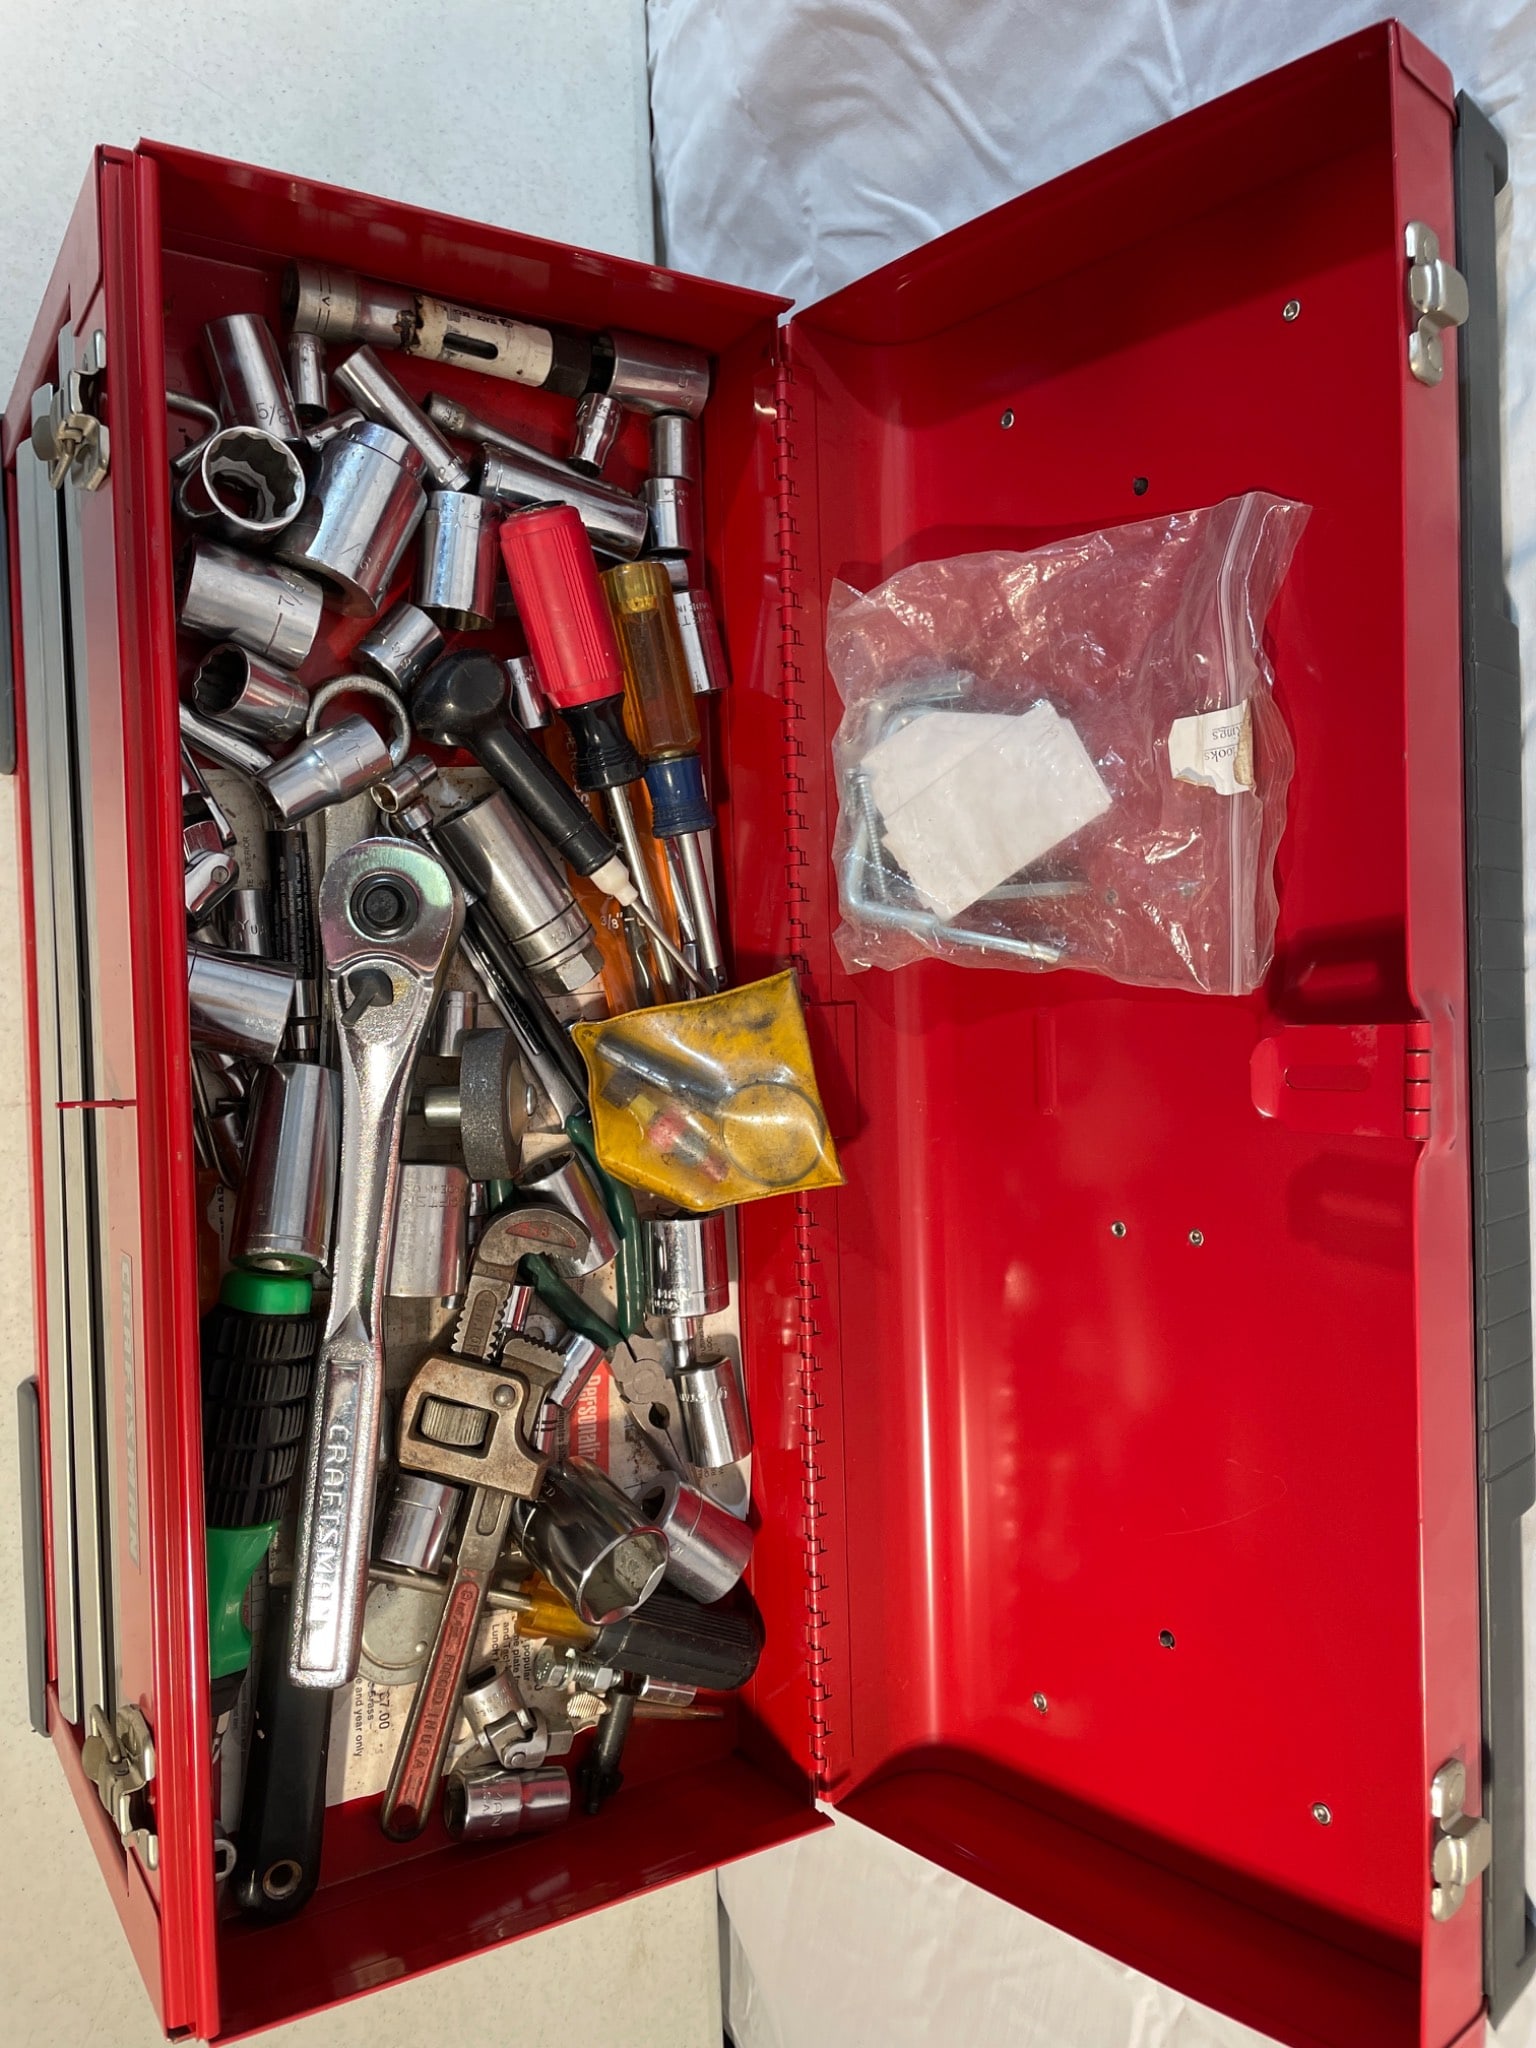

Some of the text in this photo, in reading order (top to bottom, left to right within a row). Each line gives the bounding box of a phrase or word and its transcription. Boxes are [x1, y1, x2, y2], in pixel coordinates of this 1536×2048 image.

[256, 402, 291, 427] 5/8
[120, 1255, 138, 1569] CRAFTSMAN
[313, 1422, 349, 1626] CRAFTSMAN
[503, 1622, 511, 1641] and
[511, 1649, 521, 1673] plate
[522, 1644, 532, 1682] popular
[355, 1687, 363, 1706] and
[353, 1708, 362, 1732] year
[353, 1734, 363, 1757] only
